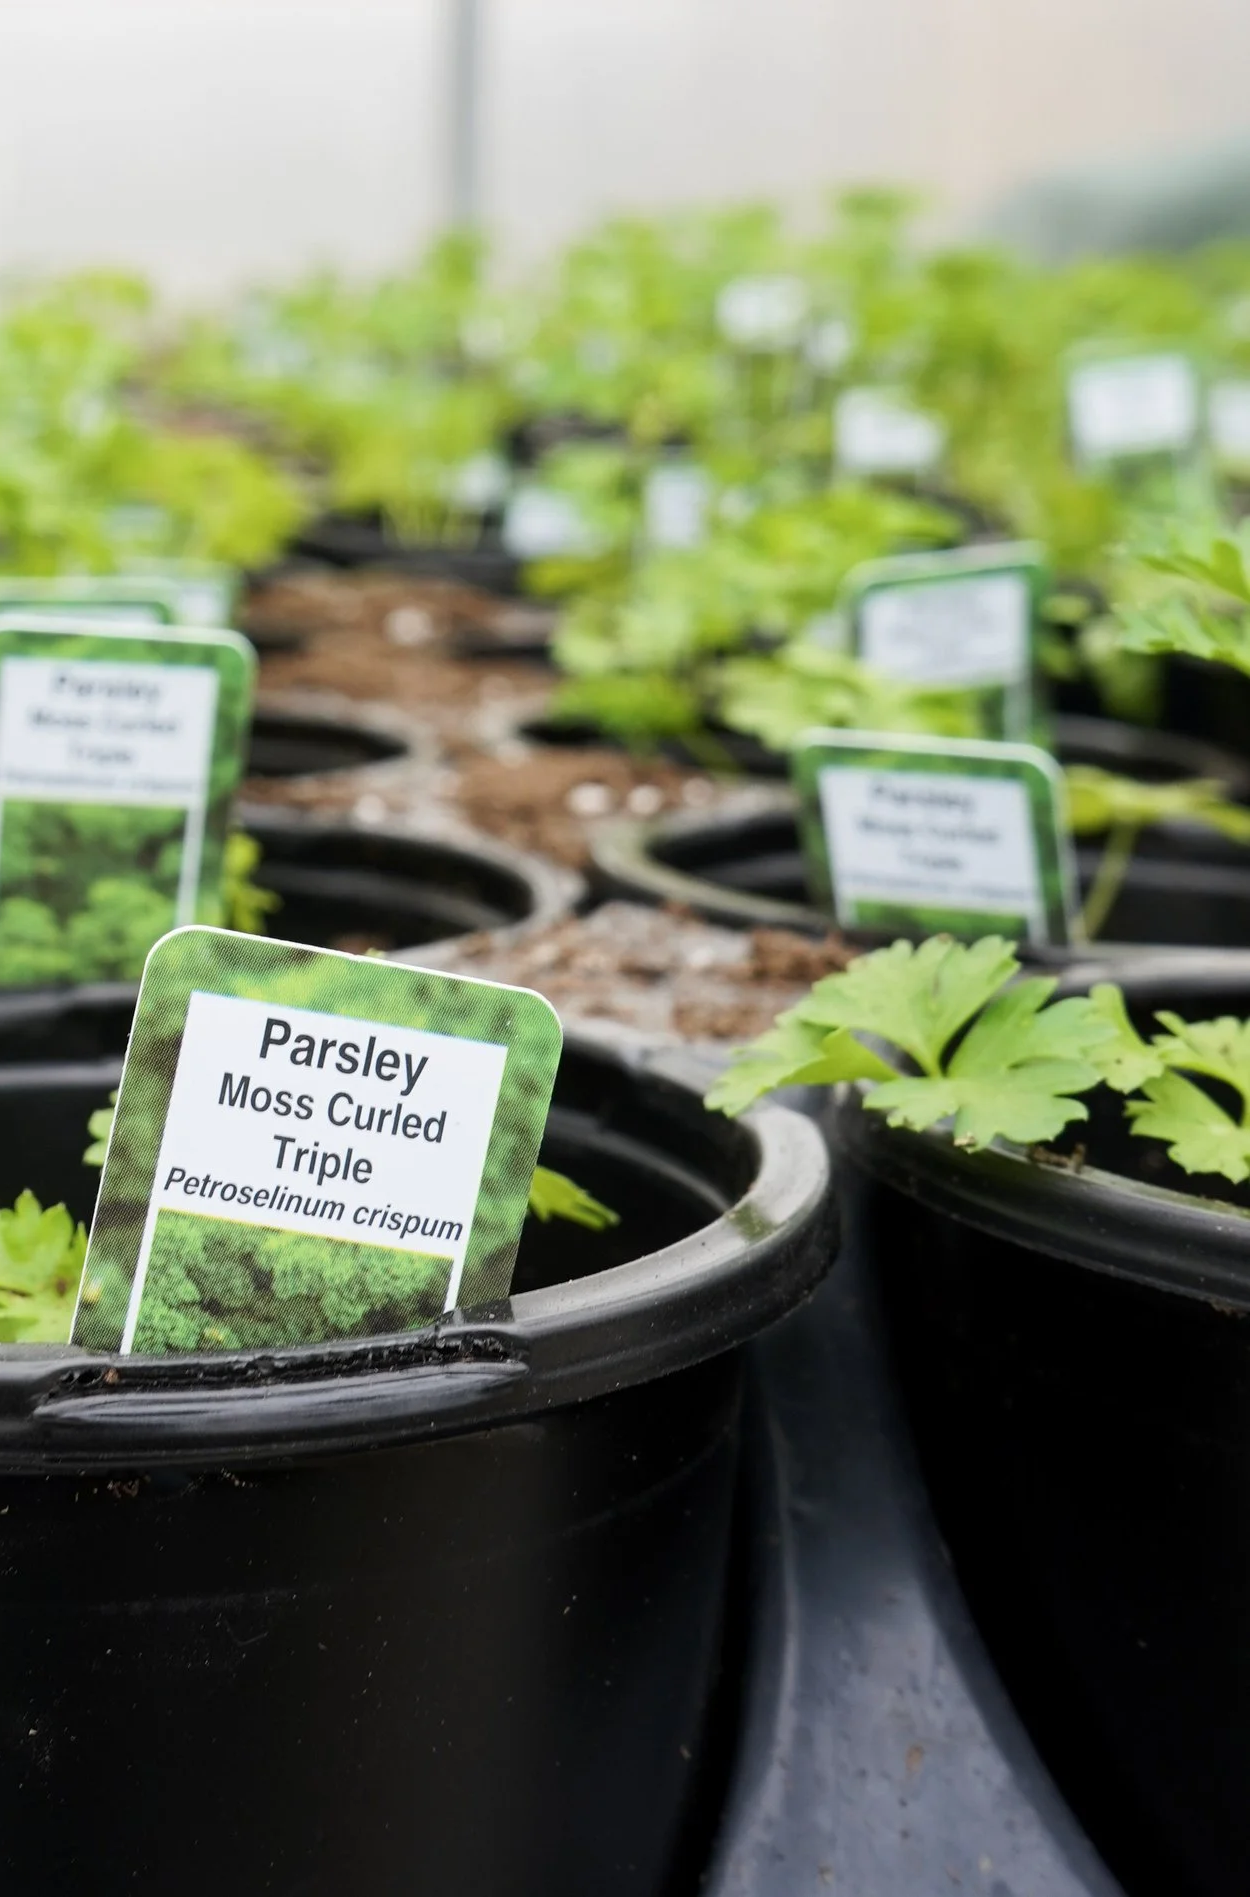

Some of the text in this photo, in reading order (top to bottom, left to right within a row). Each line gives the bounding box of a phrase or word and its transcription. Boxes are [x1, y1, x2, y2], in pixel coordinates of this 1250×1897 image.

[259, 1017, 430, 1097] Parsley
[218, 1072, 448, 1144] Moss Curled
[273, 1134, 374, 1187] Triple
[163, 1166, 464, 1242] Petroselinum crispum
